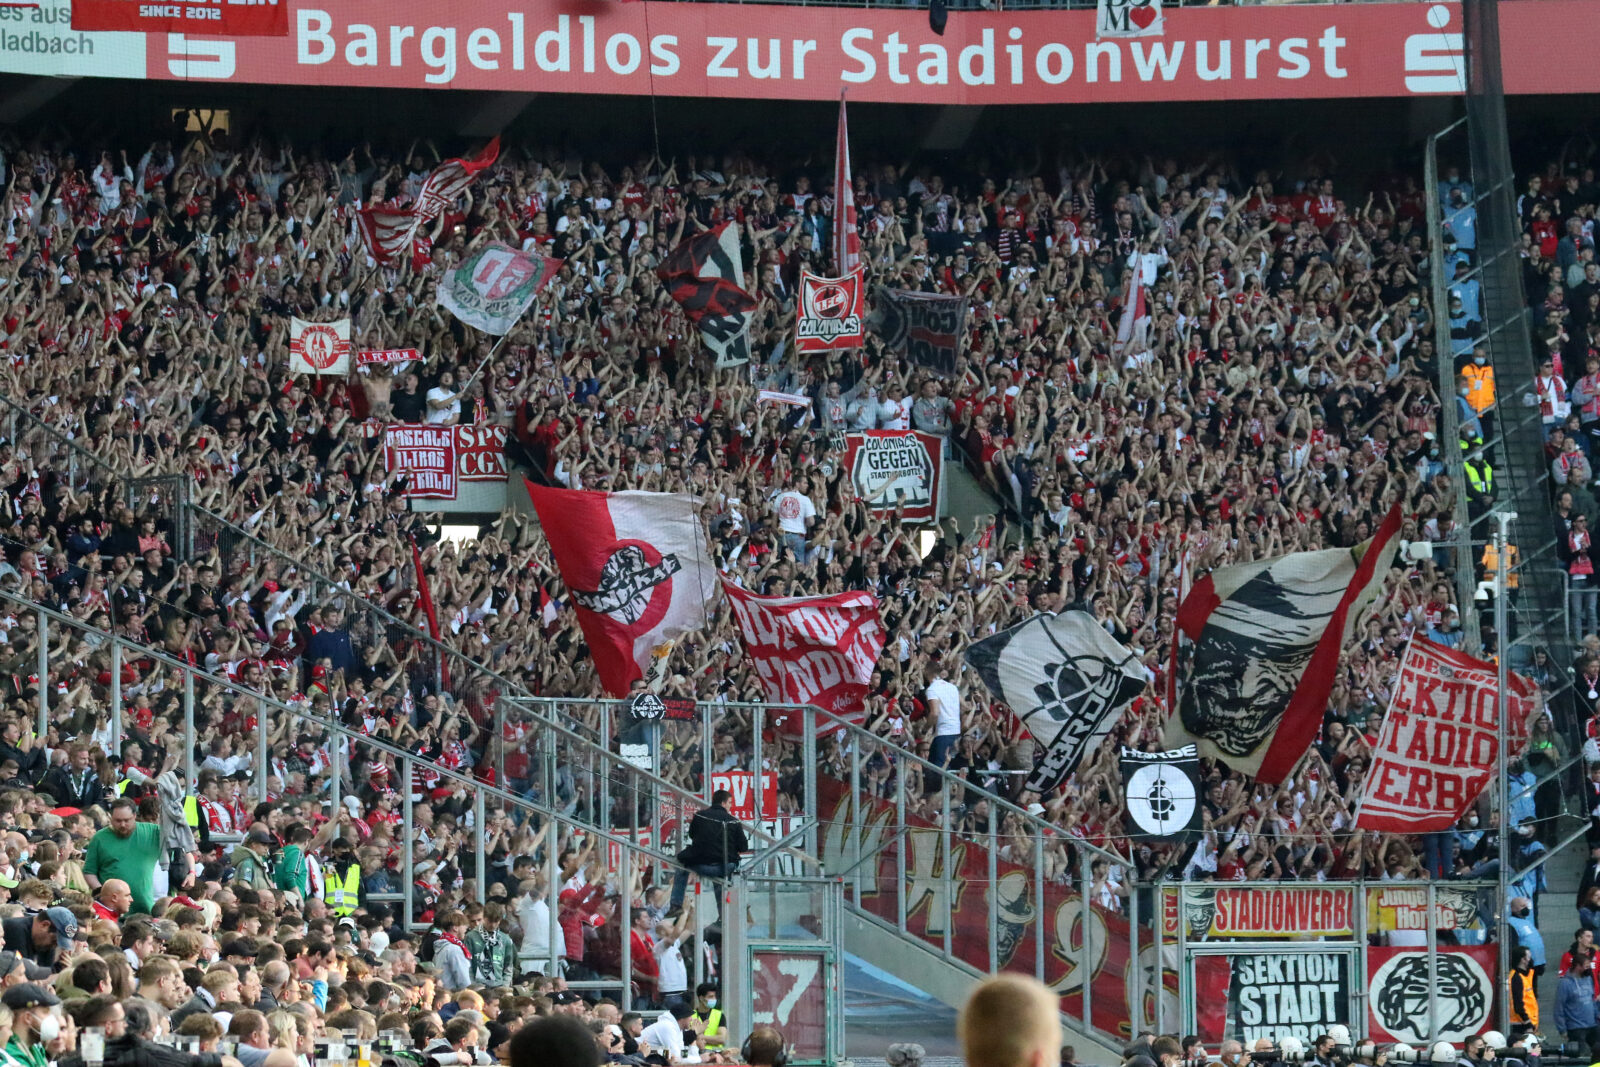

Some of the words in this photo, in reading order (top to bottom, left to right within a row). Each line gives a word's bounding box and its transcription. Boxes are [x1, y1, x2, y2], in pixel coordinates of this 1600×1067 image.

[31, 8, 71, 24] aus
[139, 5, 181, 18] SINCE
[186, 7, 221, 20] 2012
[296, 10, 682, 84] Bargeldlos
[705, 36, 815, 80] zur
[840, 24, 1349, 86] Stadionwurst
[373, 353, 383, 361] FC
[386, 350, 410, 360] KÖLN
[866, 435, 917, 450] COLONIACS
[868, 448, 920, 470] GEGEN
[1394, 667, 1536, 738] EKTION
[1380, 711, 1525, 772] TADIO
[1215, 888, 1371, 930] STADIONVERB
[1239, 954, 1339, 986] SEKTION
[1240, 983, 1339, 1026] STADT
